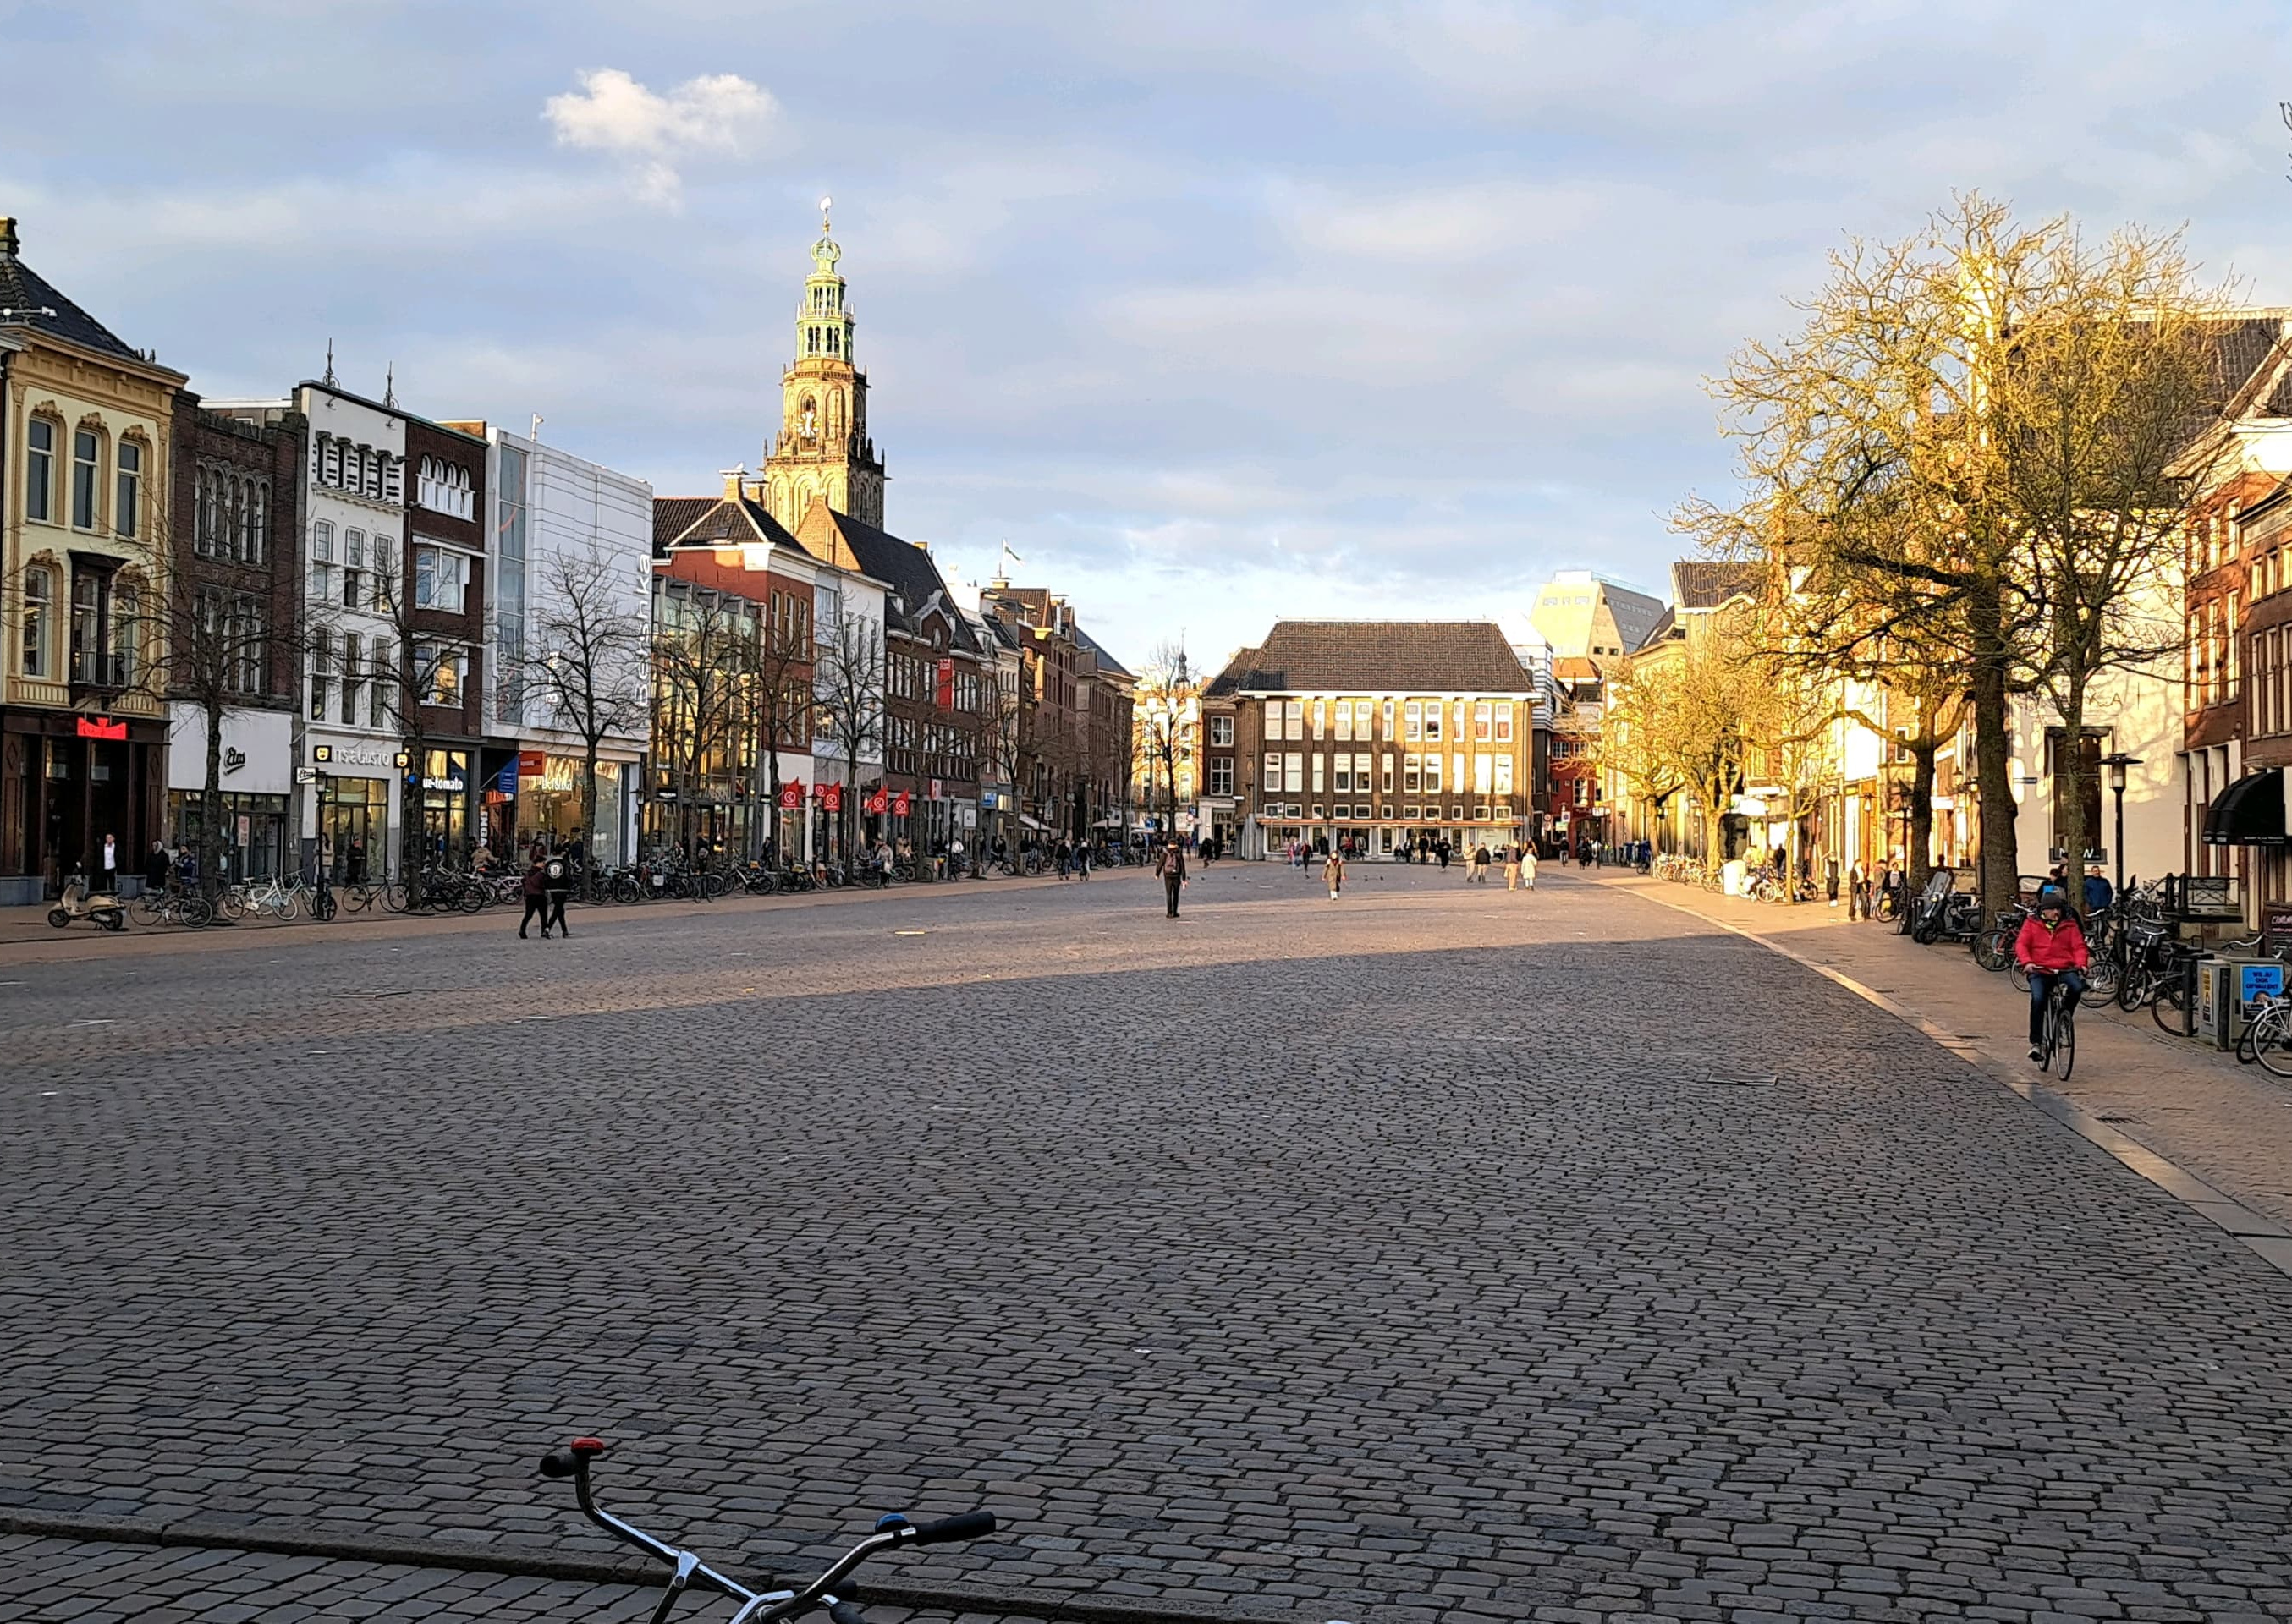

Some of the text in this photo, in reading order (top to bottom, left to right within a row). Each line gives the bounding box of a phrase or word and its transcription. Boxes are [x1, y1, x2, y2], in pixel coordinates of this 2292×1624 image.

[636, 554, 651, 707] Bershka
[224, 746, 245, 770] Etos
[357, 749, 390, 765] GUSTO
[423, 776, 463, 791] ue-tomato
